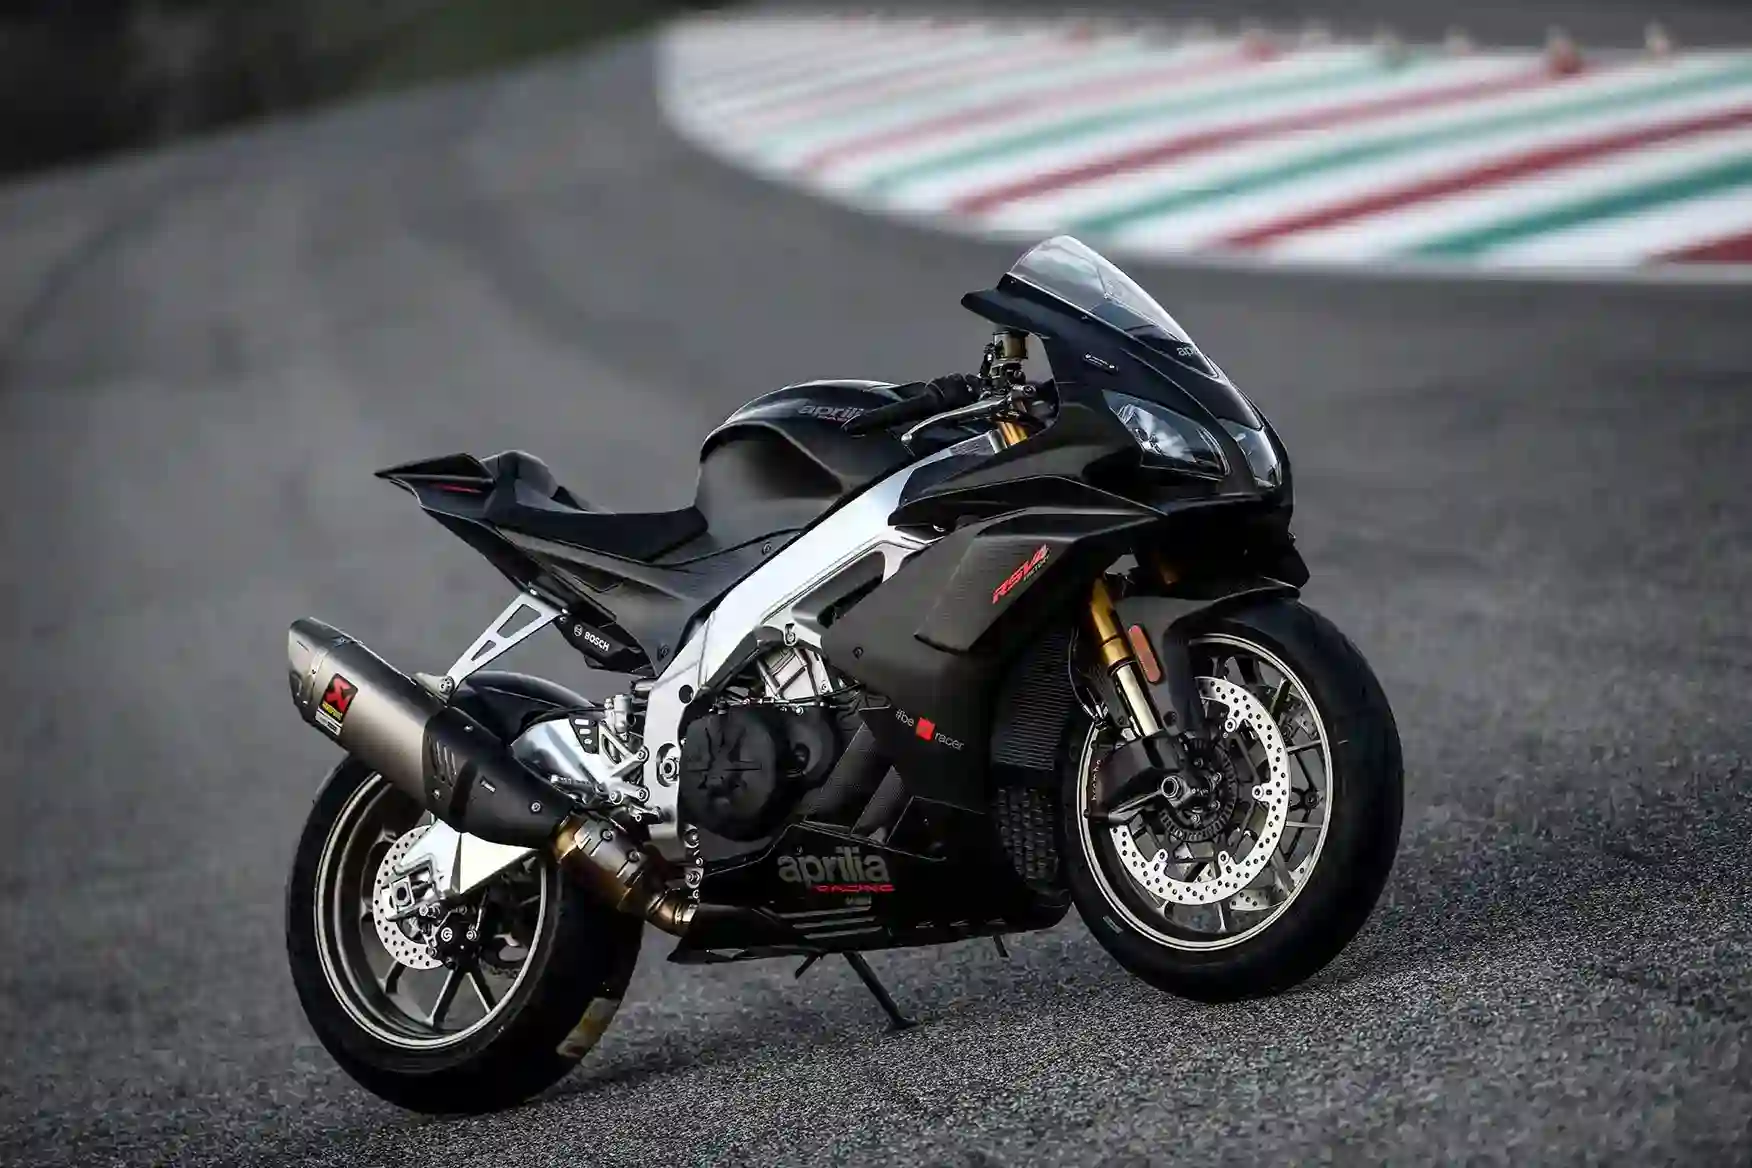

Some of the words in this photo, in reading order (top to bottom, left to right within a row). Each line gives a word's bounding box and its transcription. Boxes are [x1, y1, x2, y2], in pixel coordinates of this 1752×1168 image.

[584, 631, 610, 652] BOSCH
[934, 732, 965, 751] racer
[777, 846, 890, 889] aprilia
